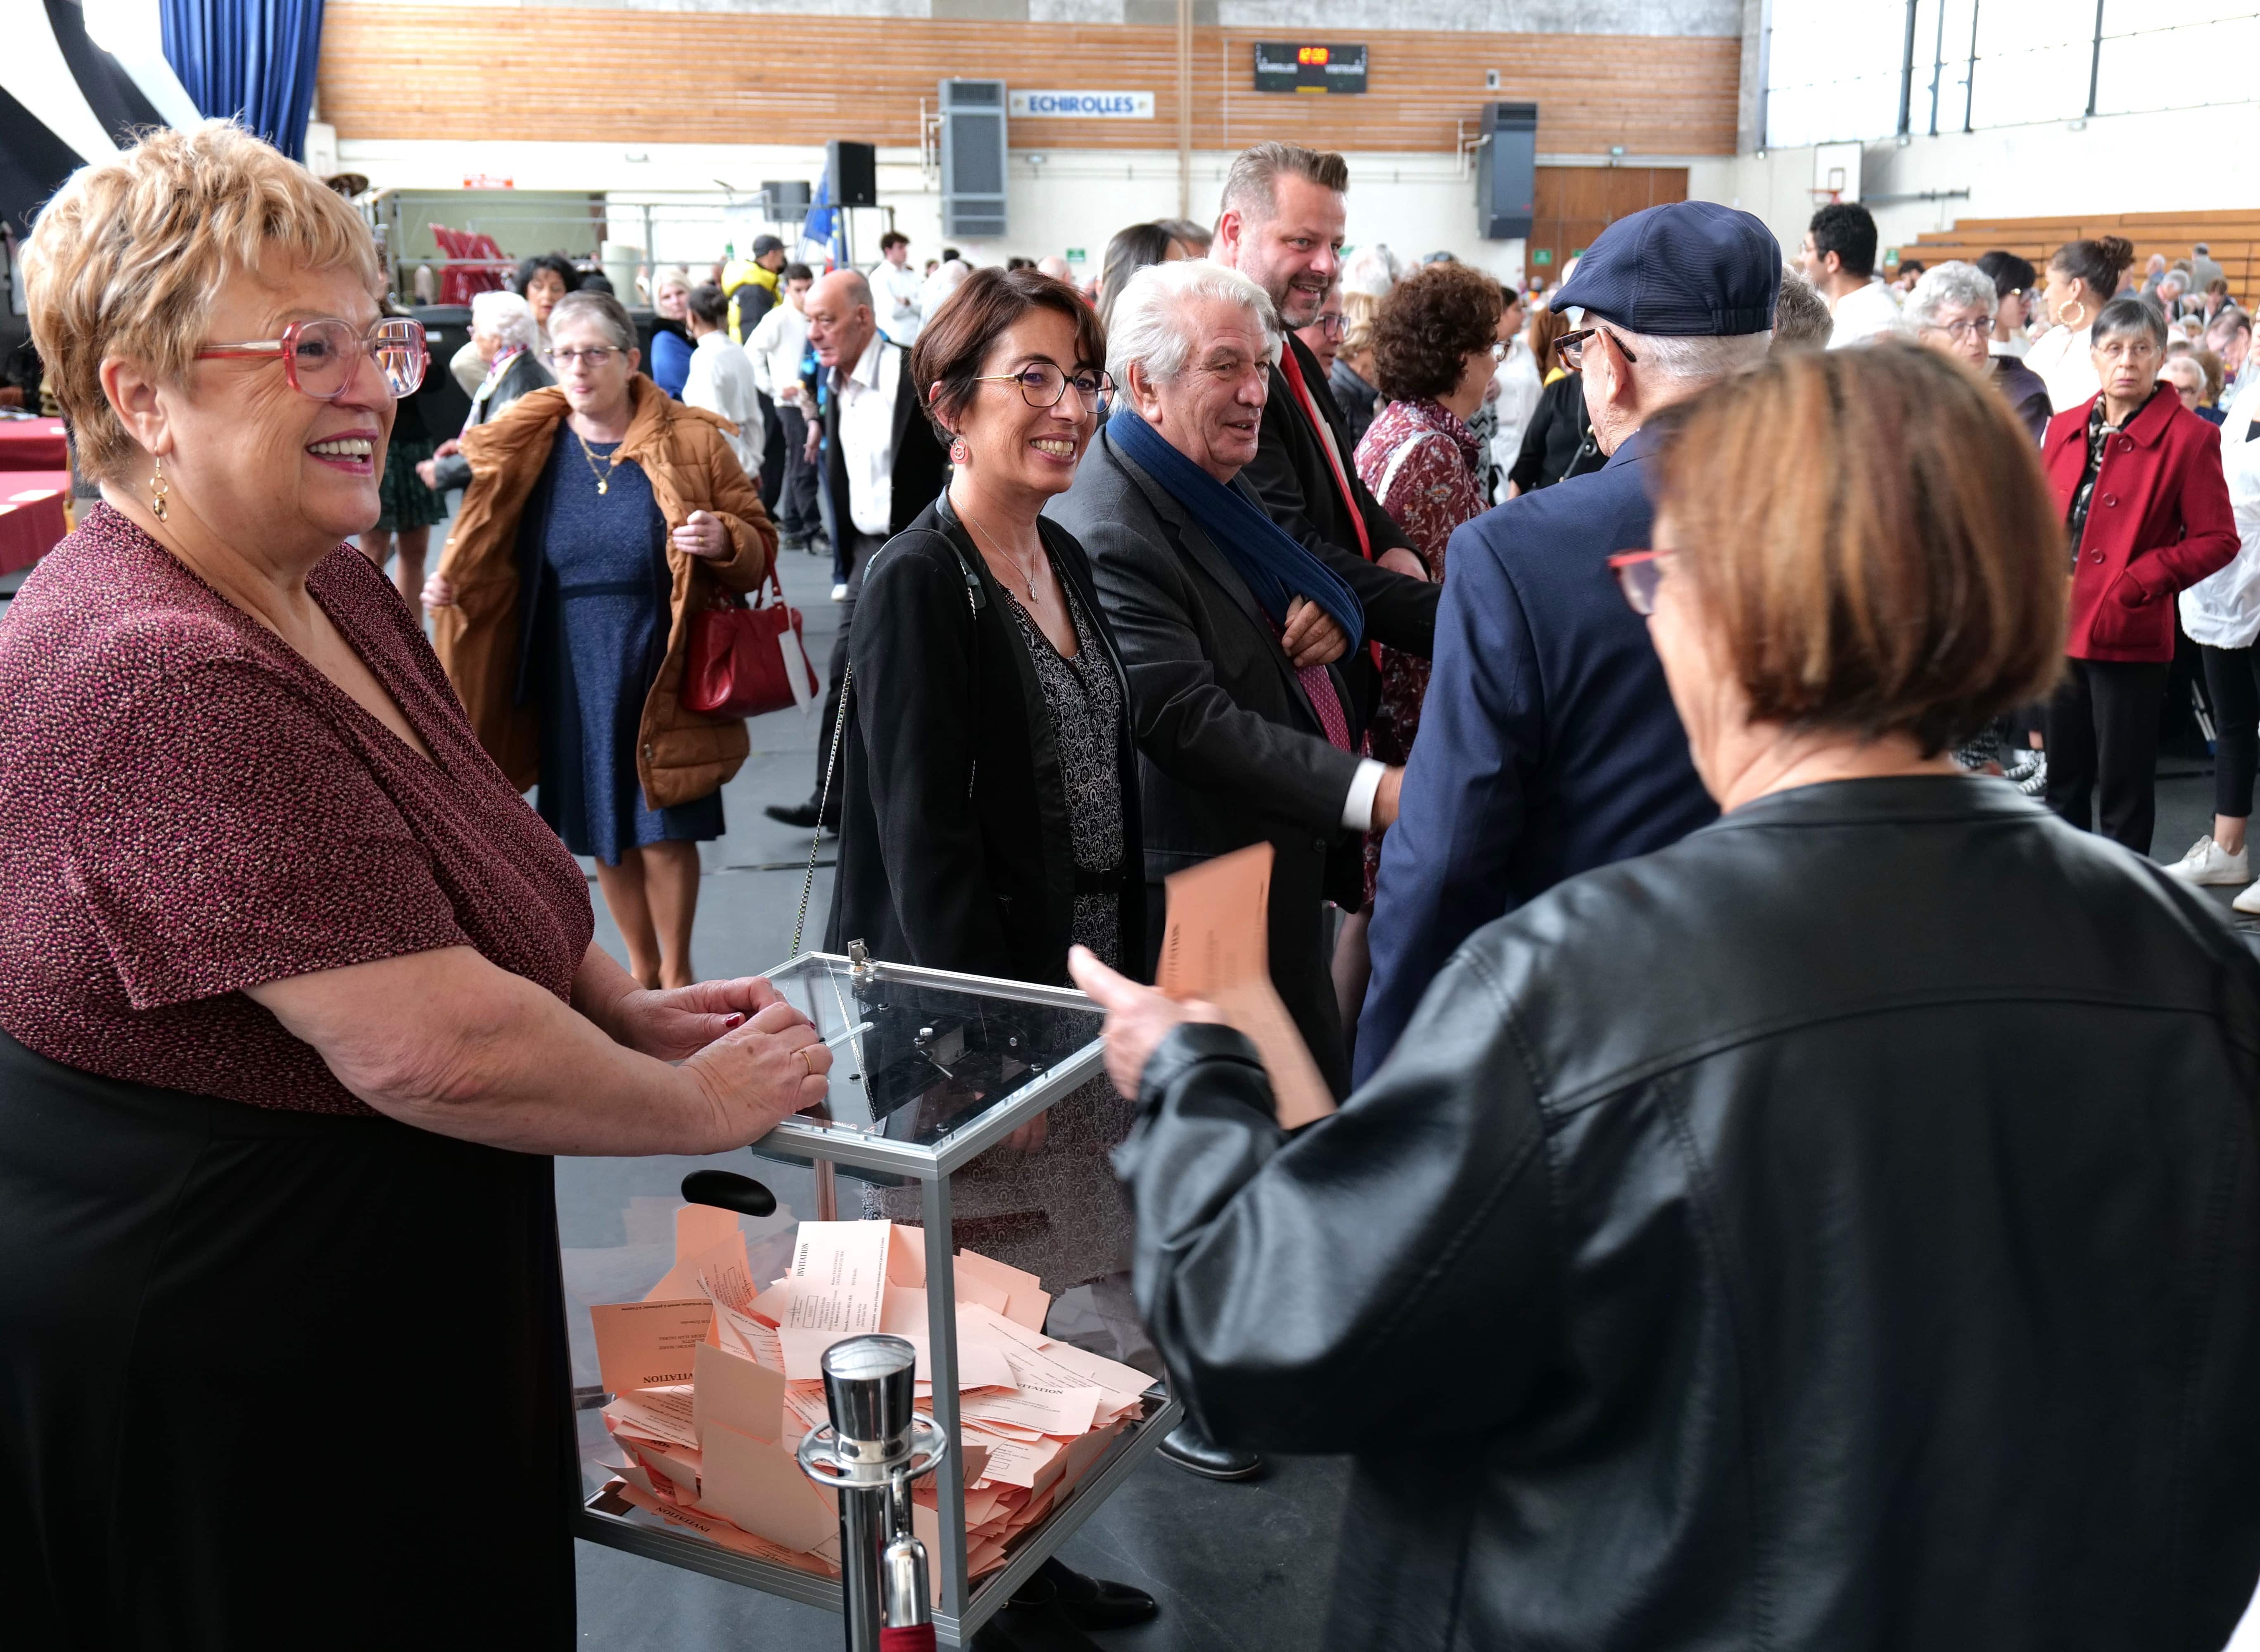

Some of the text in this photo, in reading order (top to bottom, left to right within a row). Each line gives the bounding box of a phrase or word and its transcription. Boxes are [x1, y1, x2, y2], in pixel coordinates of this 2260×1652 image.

[1028, 95, 1134, 114] ECHIROLLES
[796, 1243, 809, 1277] INVITATION
[643, 1373, 693, 1383] VITATION
[1016, 1383, 1064, 1394] VITATION
[656, 1506, 710, 1533] INVITATION
